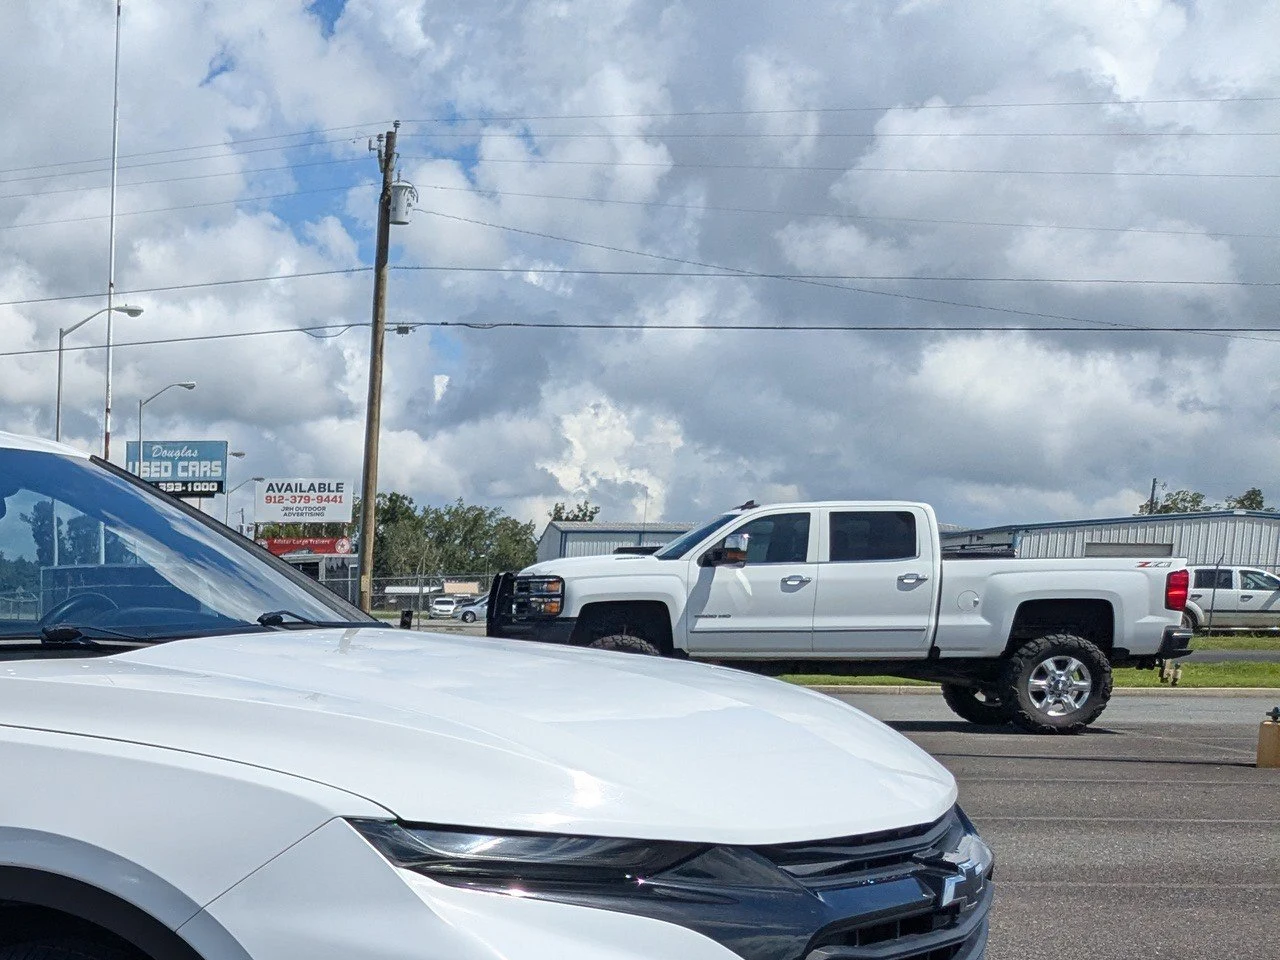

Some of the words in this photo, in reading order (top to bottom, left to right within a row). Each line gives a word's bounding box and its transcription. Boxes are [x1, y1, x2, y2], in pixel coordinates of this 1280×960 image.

[151, 445, 199, 460] Douglas
[128, 461, 172, 478] USED
[177, 461, 222, 478] CARS
[265, 482, 345, 493] AVAILABLE
[264, 495, 344, 504] 912-379-9441
